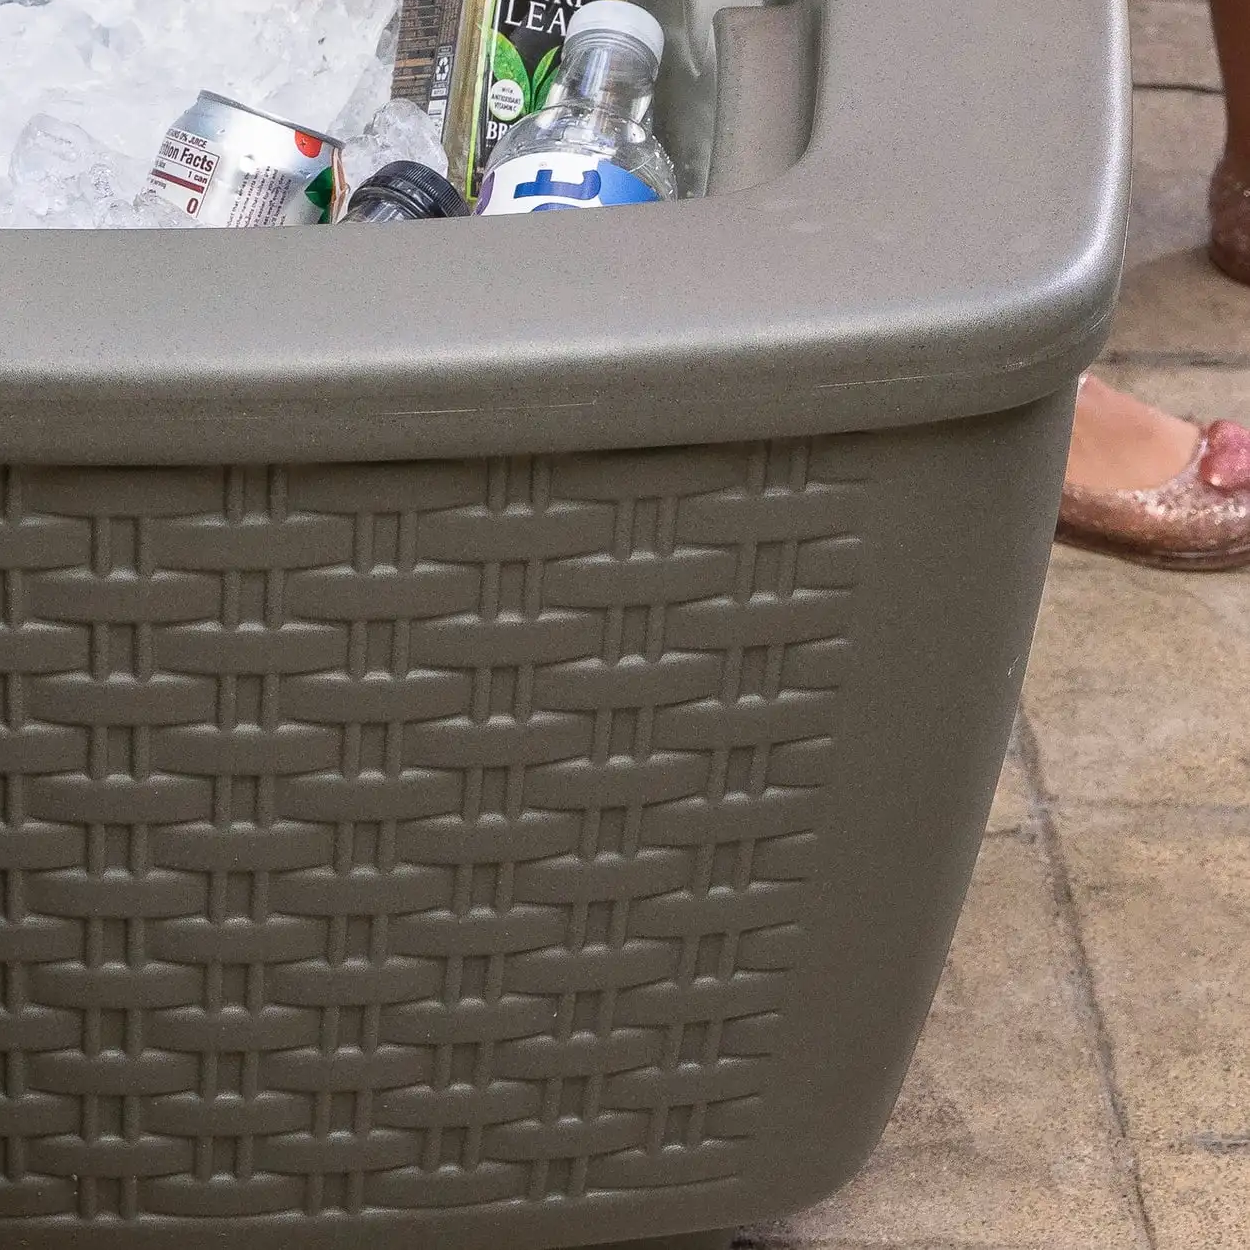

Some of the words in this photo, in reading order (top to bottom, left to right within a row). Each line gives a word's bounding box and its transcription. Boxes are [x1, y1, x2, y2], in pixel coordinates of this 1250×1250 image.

[188, 136, 208, 149] JUICE
[180, 147, 214, 172] Facts
[193, 174, 208, 184] can
[186, 197, 199, 214] 0
